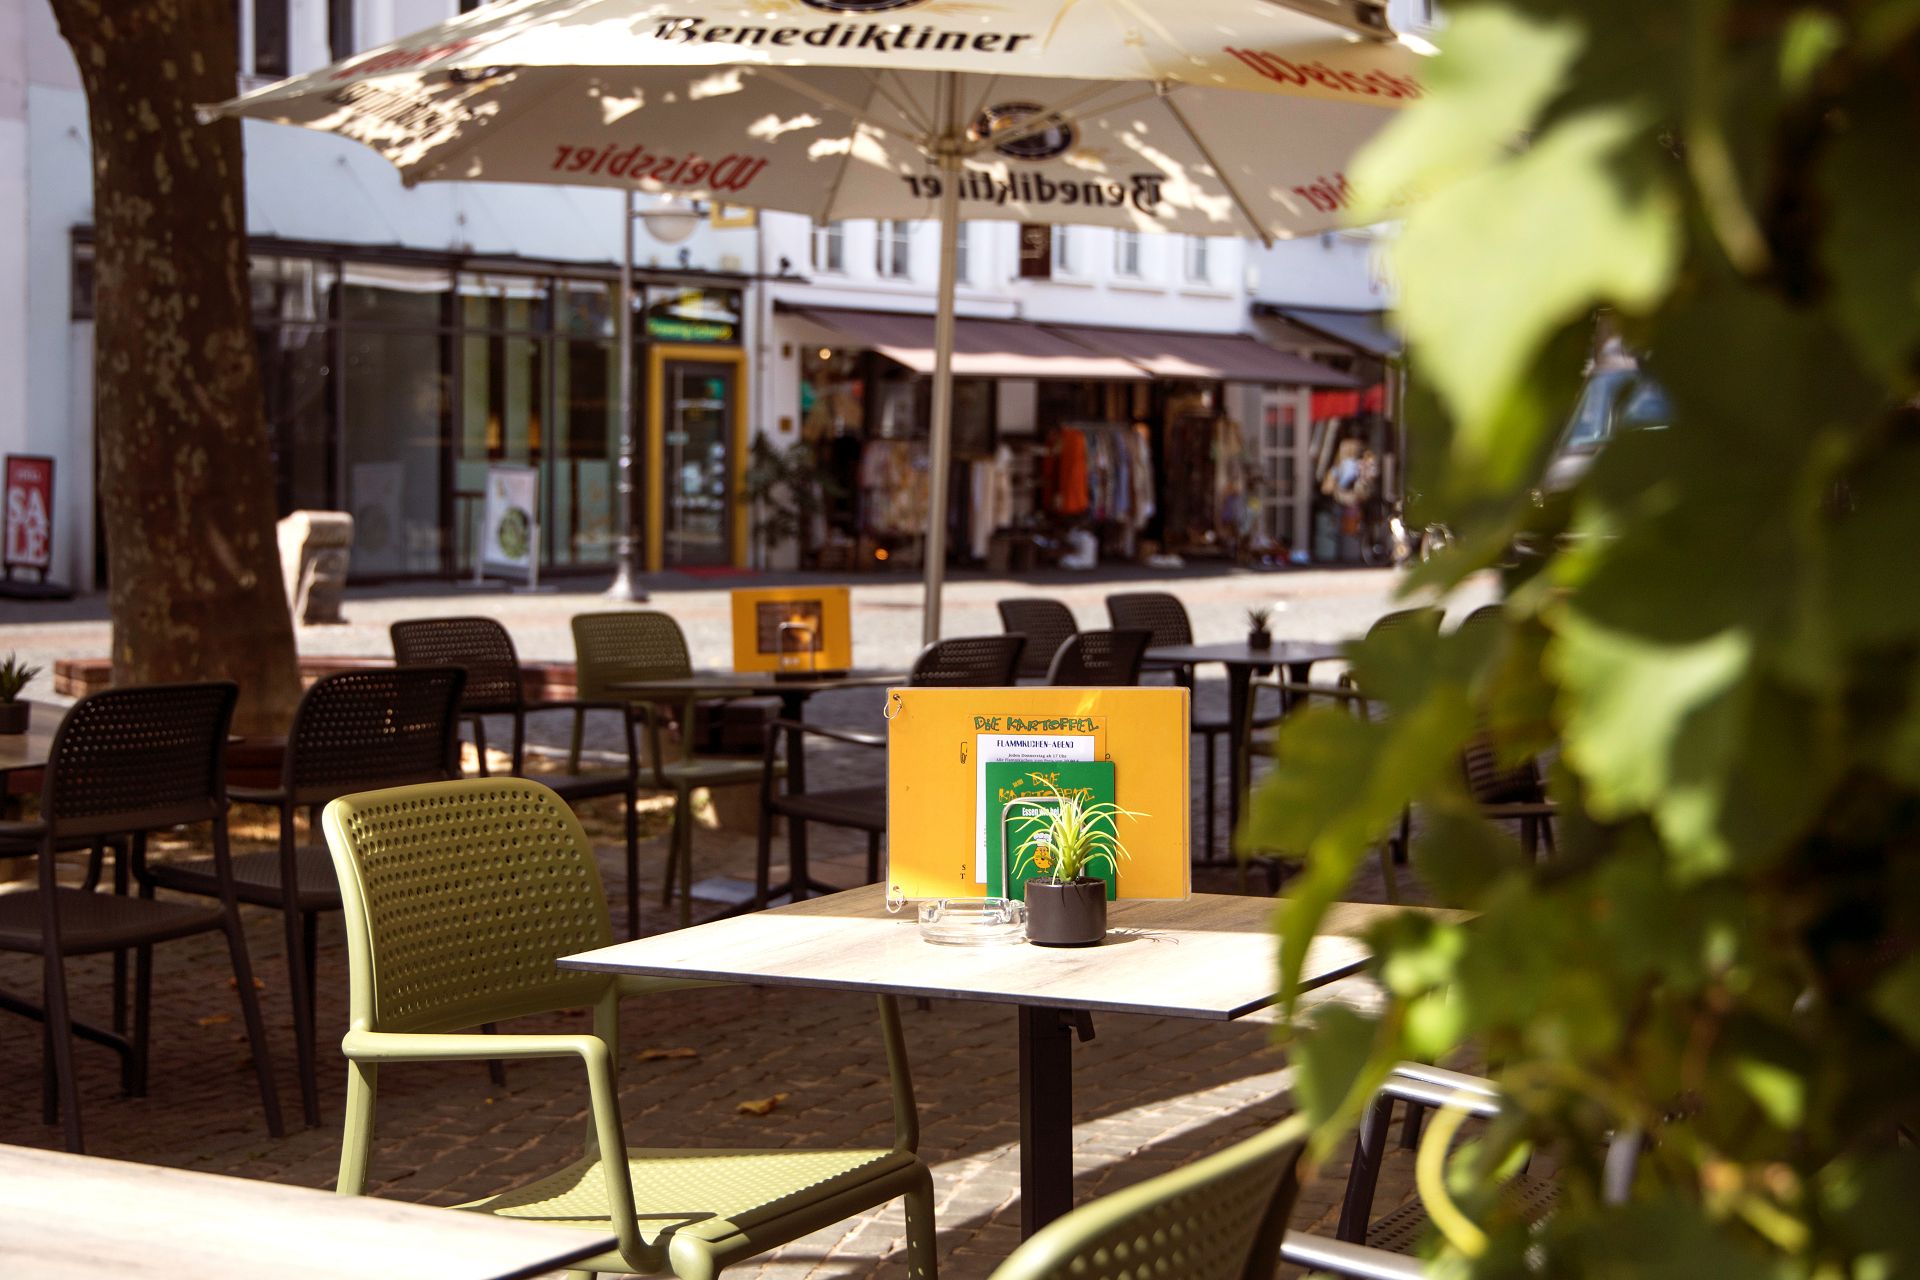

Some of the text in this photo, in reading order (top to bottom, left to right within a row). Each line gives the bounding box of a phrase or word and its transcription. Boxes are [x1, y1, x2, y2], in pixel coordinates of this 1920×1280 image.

[655, 16, 1033, 53] Benediktiner
[1006, 716, 1099, 732] KARTOFFEL
[1022, 807, 1039, 816] Essen
